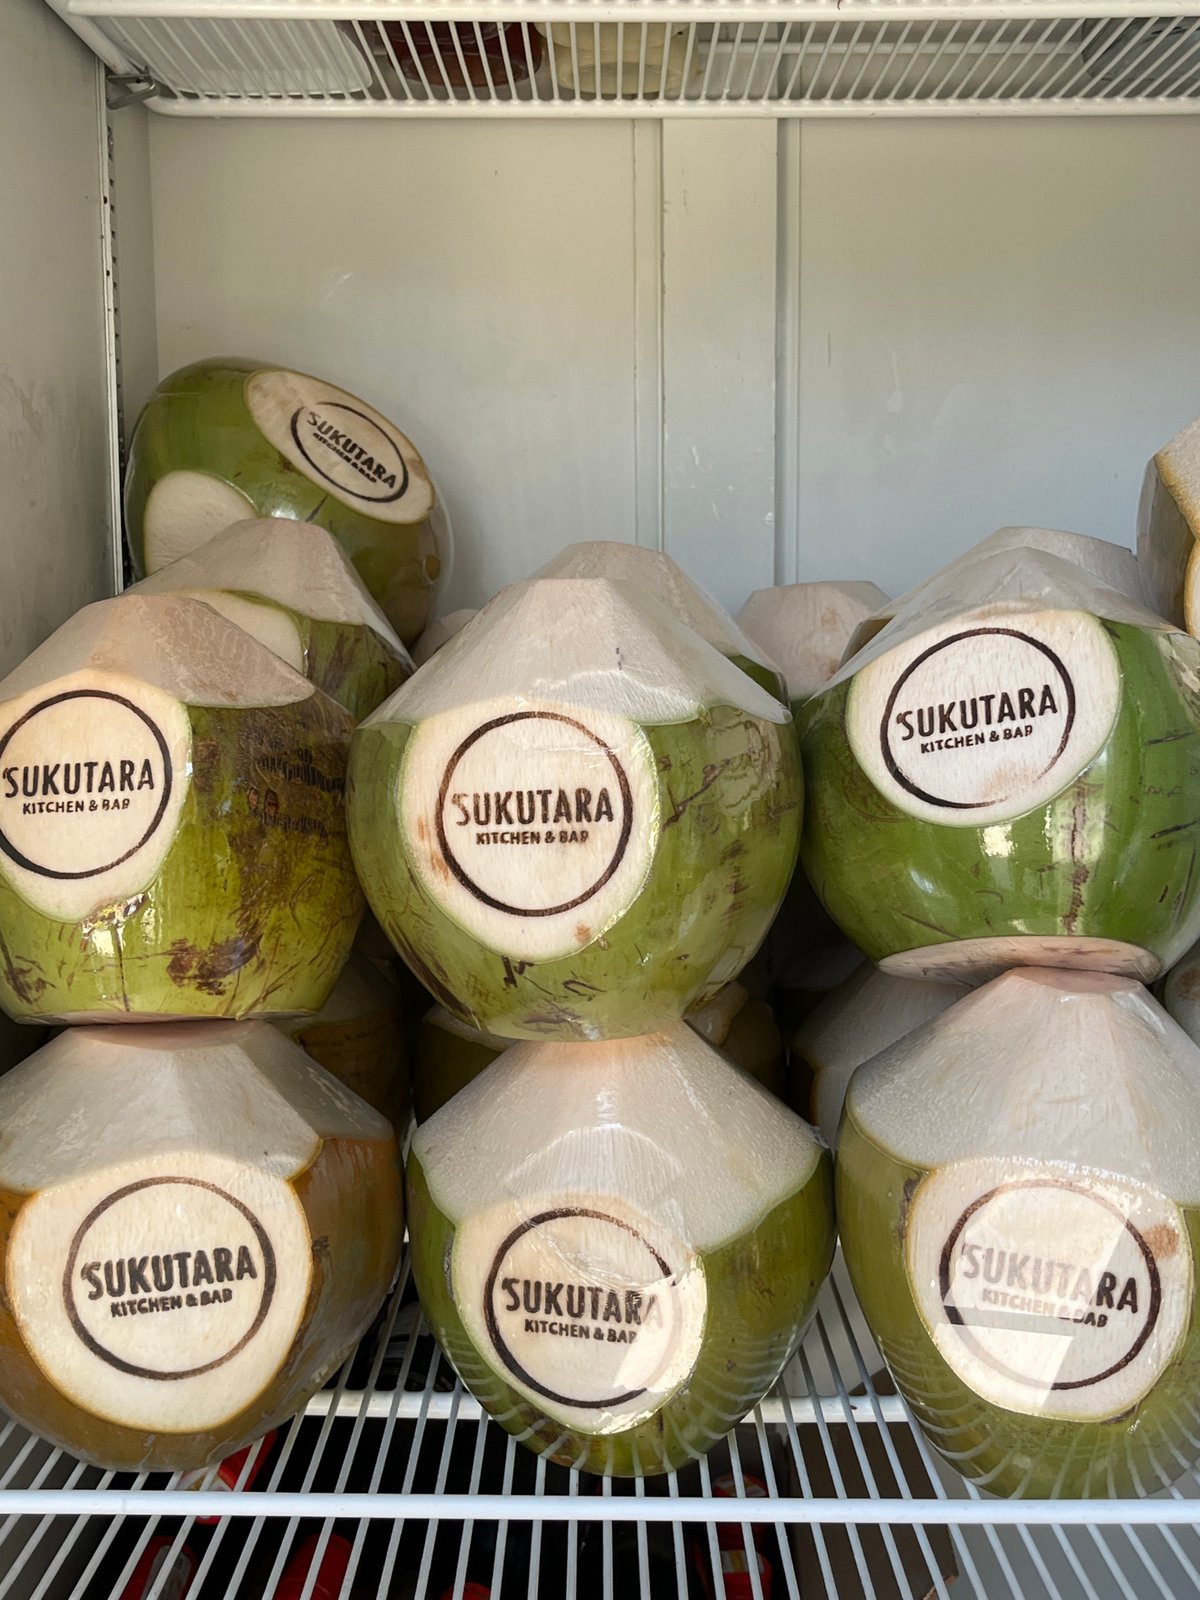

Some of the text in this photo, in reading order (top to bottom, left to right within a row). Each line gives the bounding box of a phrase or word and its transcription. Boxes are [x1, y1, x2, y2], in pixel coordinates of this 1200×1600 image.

[307, 411, 397, 489] SUKUTARA
[896, 684, 1058, 741] SUKUTARA
[921, 732, 985, 754] KITCHEN
[989, 730, 1000, 743] &
[3, 758, 154, 798] SUKUTARA
[23, 801, 84, 815] KITCHEN
[89, 800, 98, 811] &
[451, 787, 614, 826] SUKUTARA
[476, 831, 540, 845] KITCHEN
[545, 831, 555, 844] &
[80, 1245, 258, 1300] SUKUTARA
[962, 1243, 1139, 1313] SUKUTARA
[111, 1295, 182, 1318] KITCHEN
[186, 1293, 198, 1307] &
[502, 1277, 664, 1329] SUKUTARA
[982, 1288, 1055, 1316] KITCHEN
[524, 1319, 590, 1339] KITCHEN
[593, 1327, 604, 1340] &
